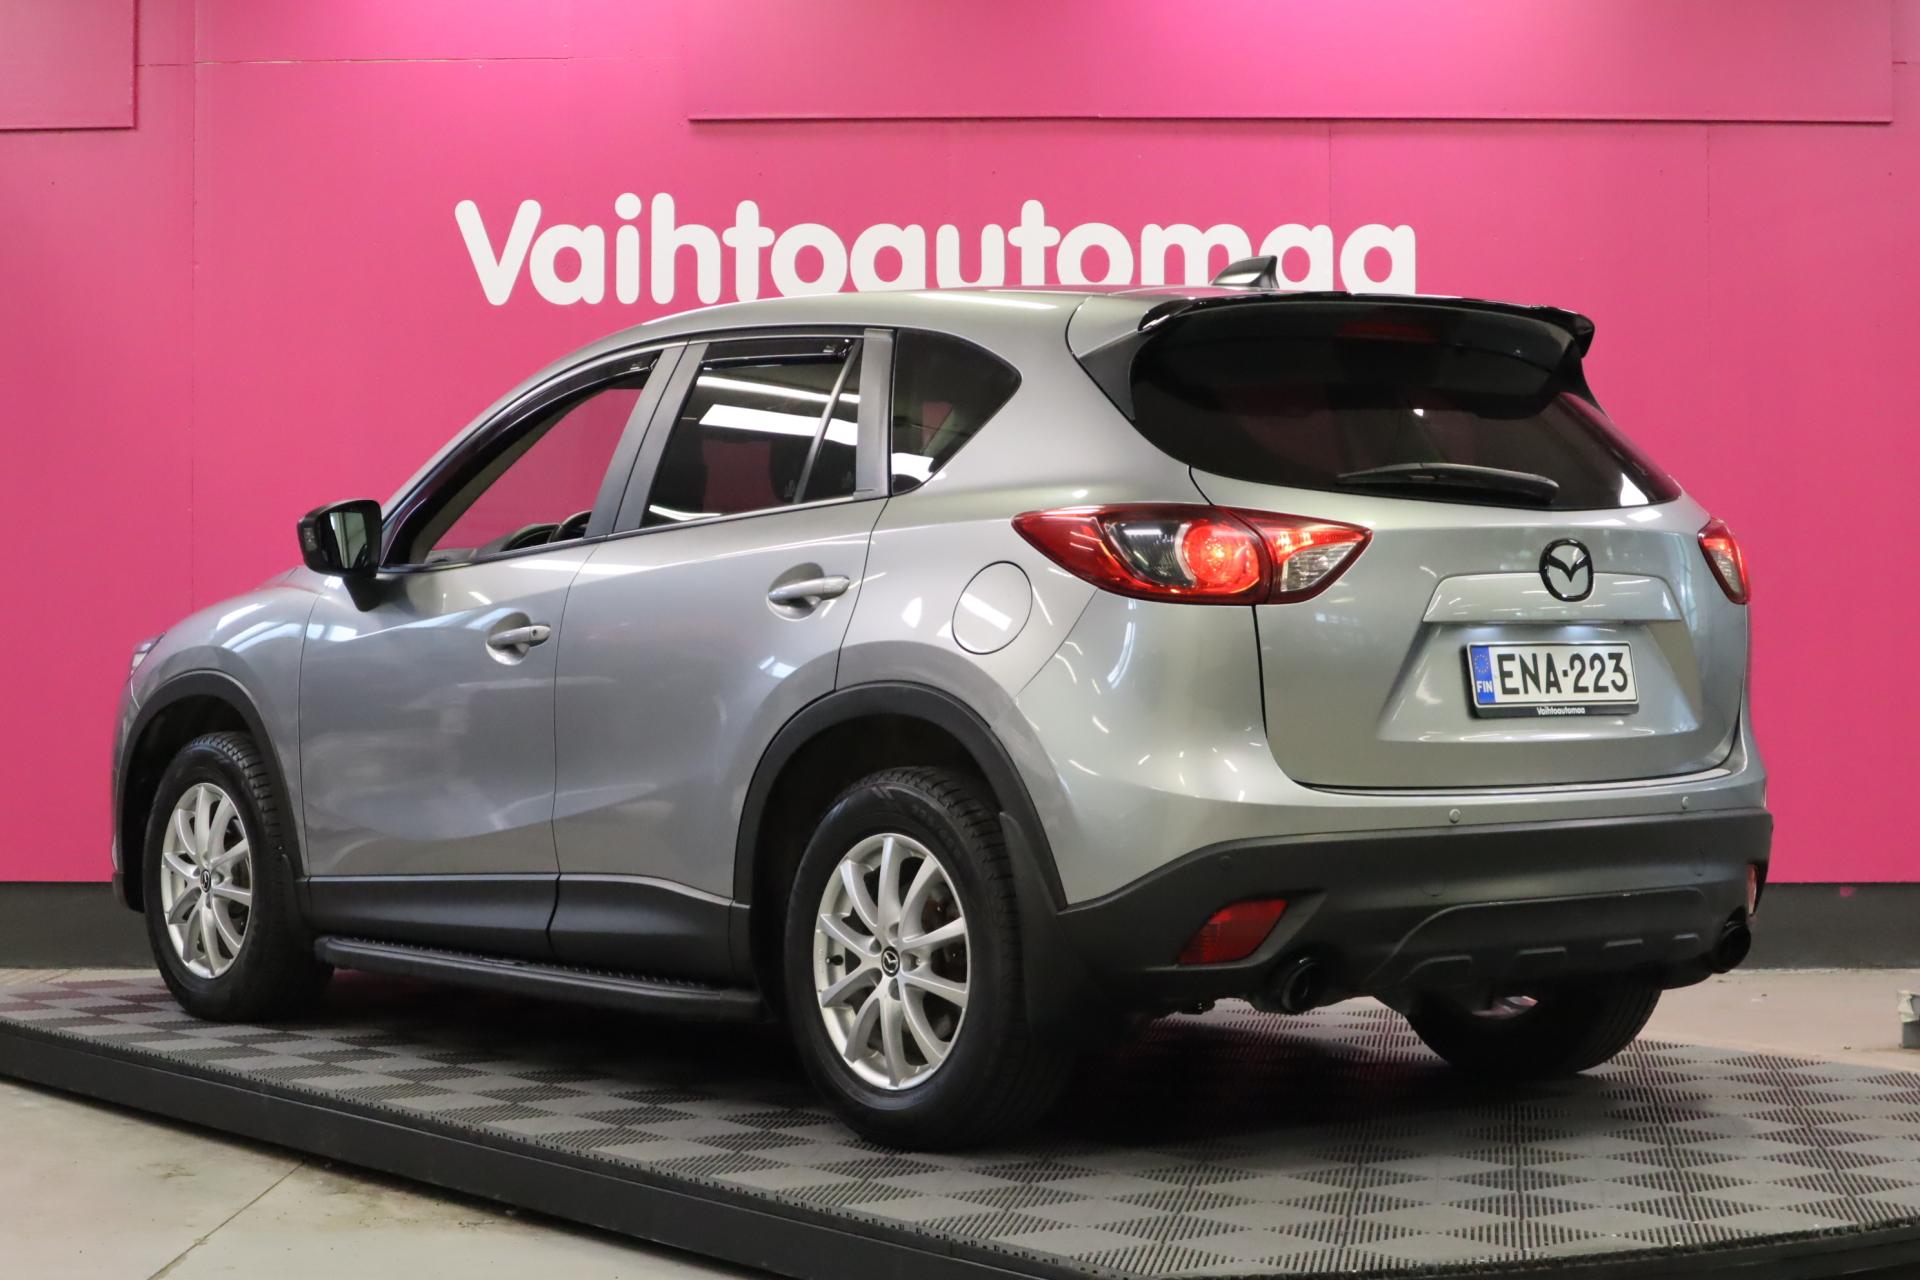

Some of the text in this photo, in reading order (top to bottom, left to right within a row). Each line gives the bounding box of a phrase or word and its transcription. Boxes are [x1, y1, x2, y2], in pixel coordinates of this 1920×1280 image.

[455, 192, 1416, 305] Vaihtoautomaa
[1476, 680, 1493, 694] FIN
[1497, 652, 1628, 695] ENA-223
[1536, 706, 1586, 716] Vaihtoautomaa
